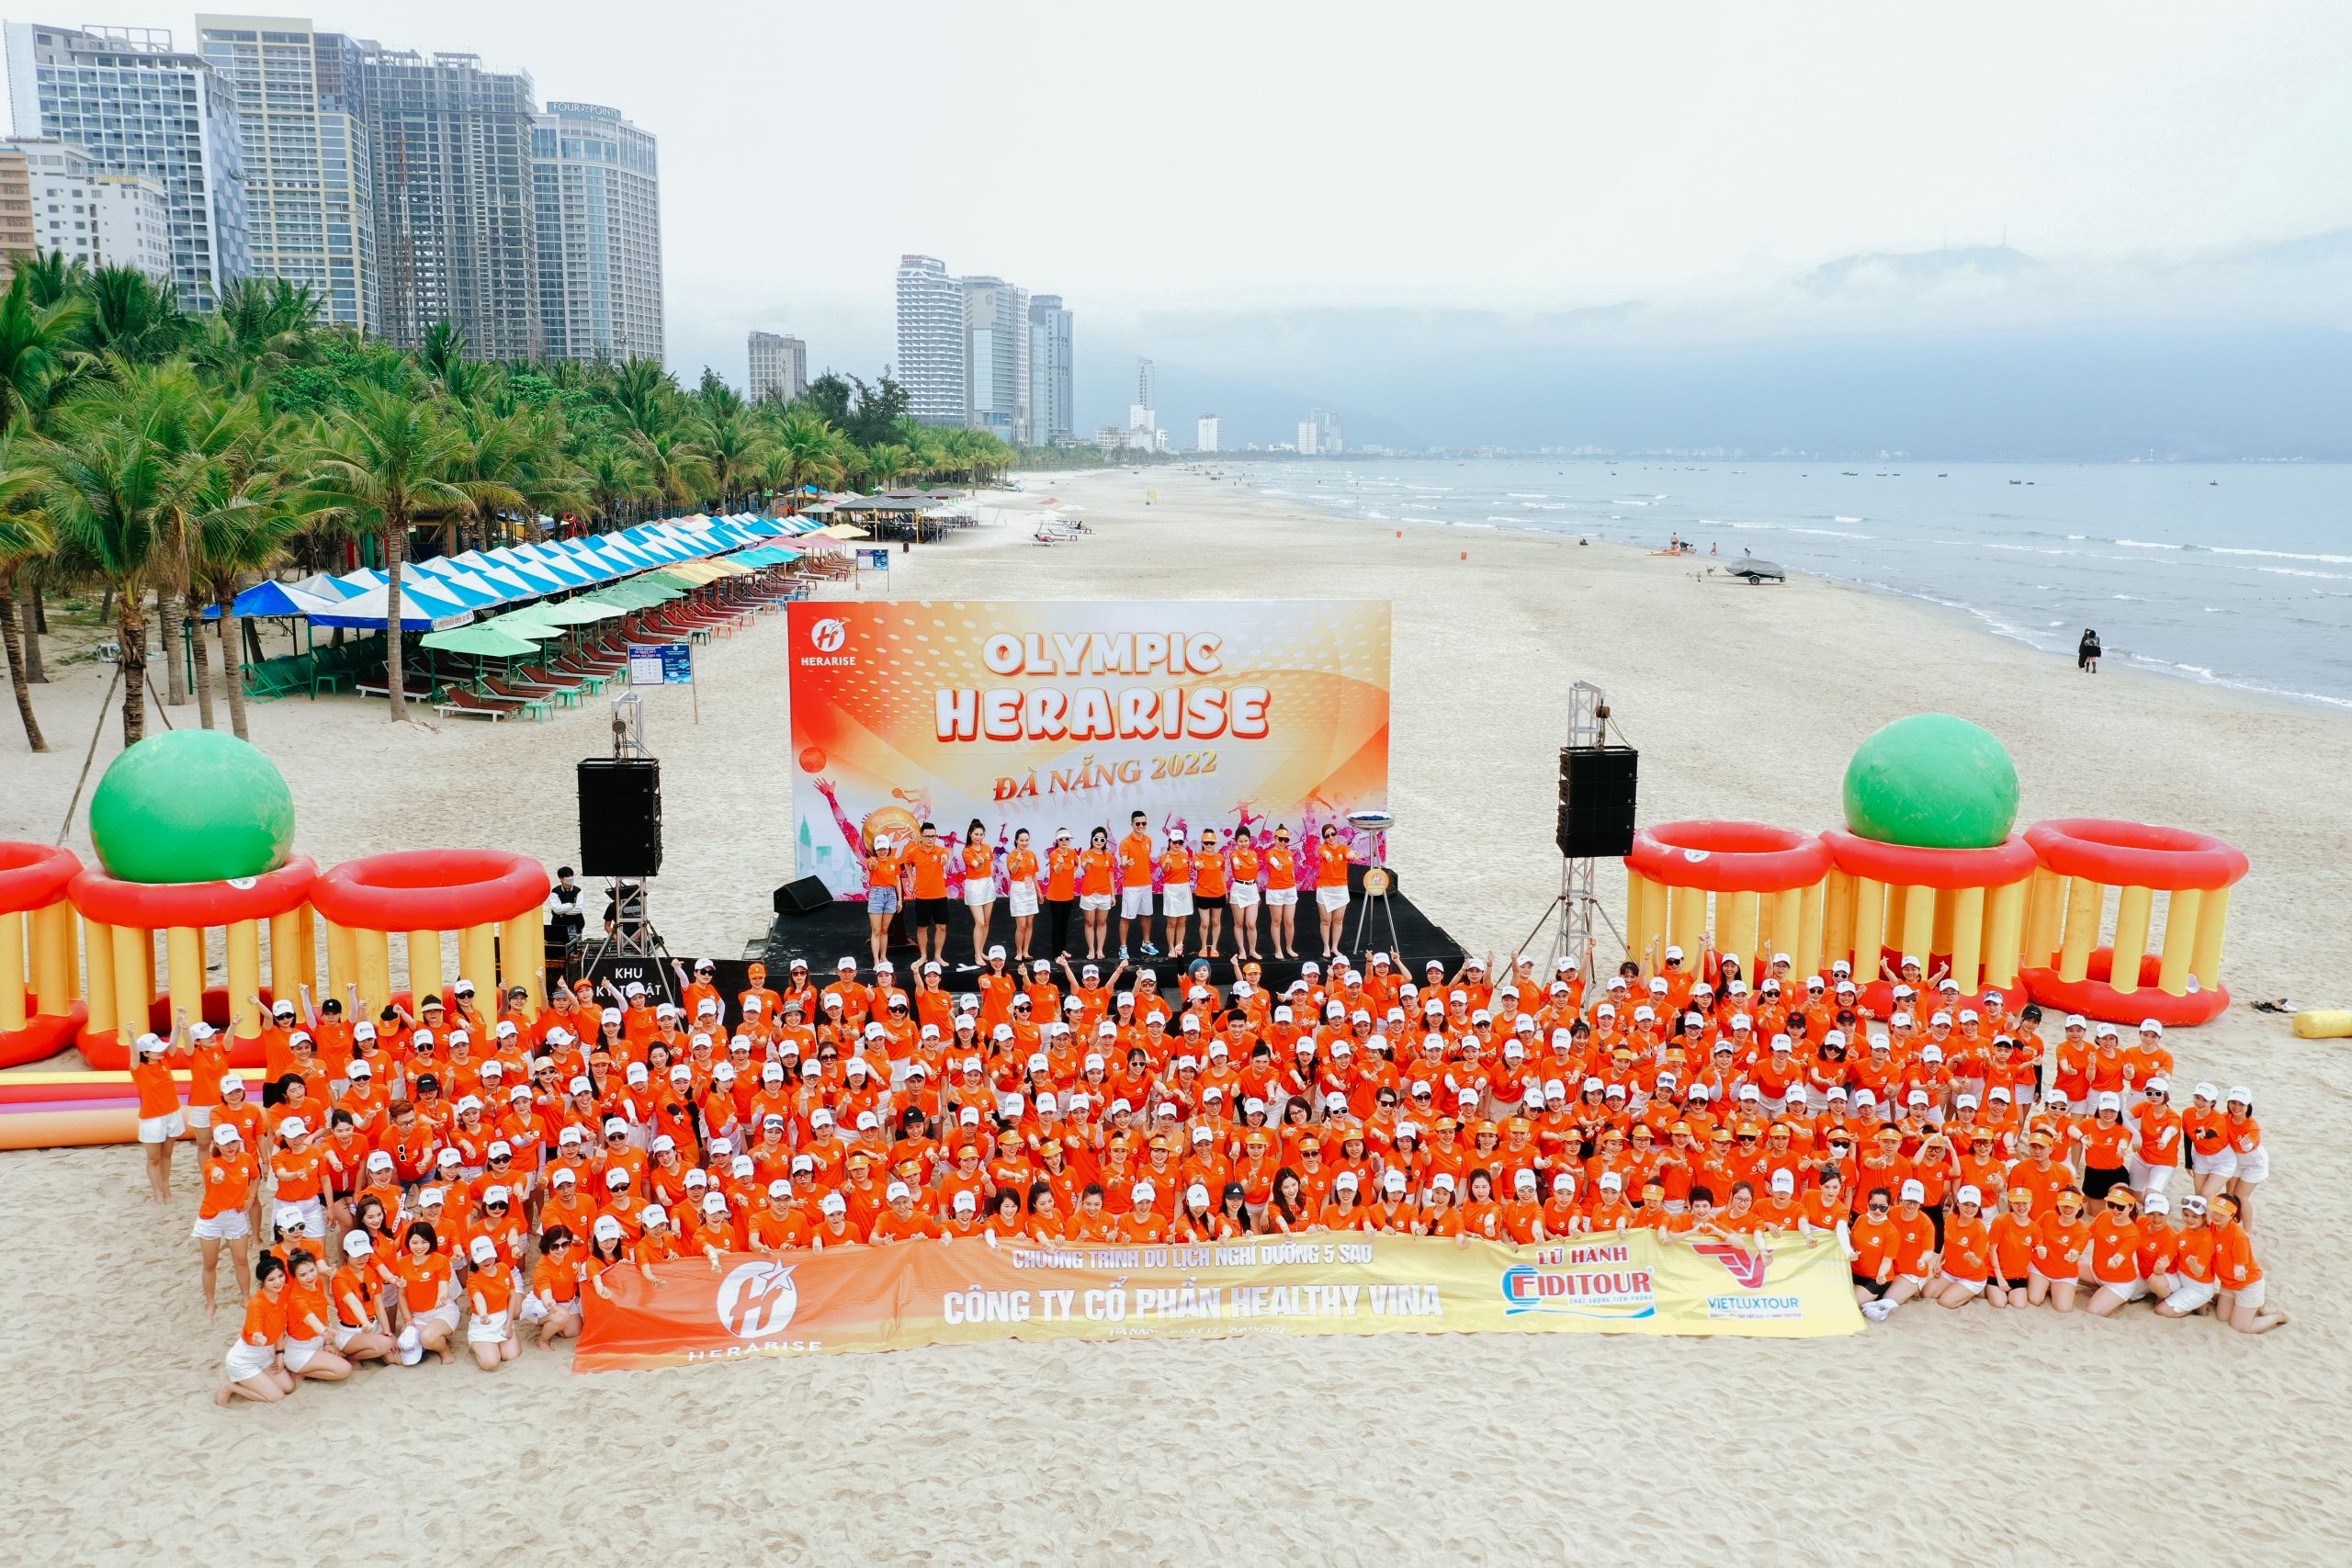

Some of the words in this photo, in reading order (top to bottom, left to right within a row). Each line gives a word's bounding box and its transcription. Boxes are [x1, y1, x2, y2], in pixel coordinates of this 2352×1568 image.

[553, 102, 580, 112] FOUR
[590, 105, 618, 118] POINTS
[801, 656, 856, 666] HERARISE
[983, 632, 1223, 677] OLYMPIC
[935, 686, 1272, 742] HERARISE
[992, 766, 1040, 801] ĐÀ
[1150, 750, 1217, 780] 2022
[615, 967, 643, 979] KHU
[619, 982, 662, 998] TẬT
[1144, 1248, 1168, 1268] DU
[1172, 1245, 1211, 1271] LỊCH
[1322, 1244, 1335, 1264] 5
[1338, 1243, 1374, 1264] SAO
[1538, 1247, 1564, 1265] LỮ
[1571, 1246, 1628, 1264] HÀNH
[1511, 1271, 1653, 1297] FIDITOUR
[944, 1283, 1031, 1325] CÔNG
[1038, 1289, 1075, 1322] TY
[1084, 1274, 1129, 1322] CỔ
[1136, 1275, 1222, 1322] PHẦN
[1229, 1283, 1362, 1319] HEALTHY
[1366, 1283, 1445, 1318] VINA
[1707, 1297, 1800, 1309] VIETLUXTOUR
[688, 1340, 823, 1361] HERARISE
